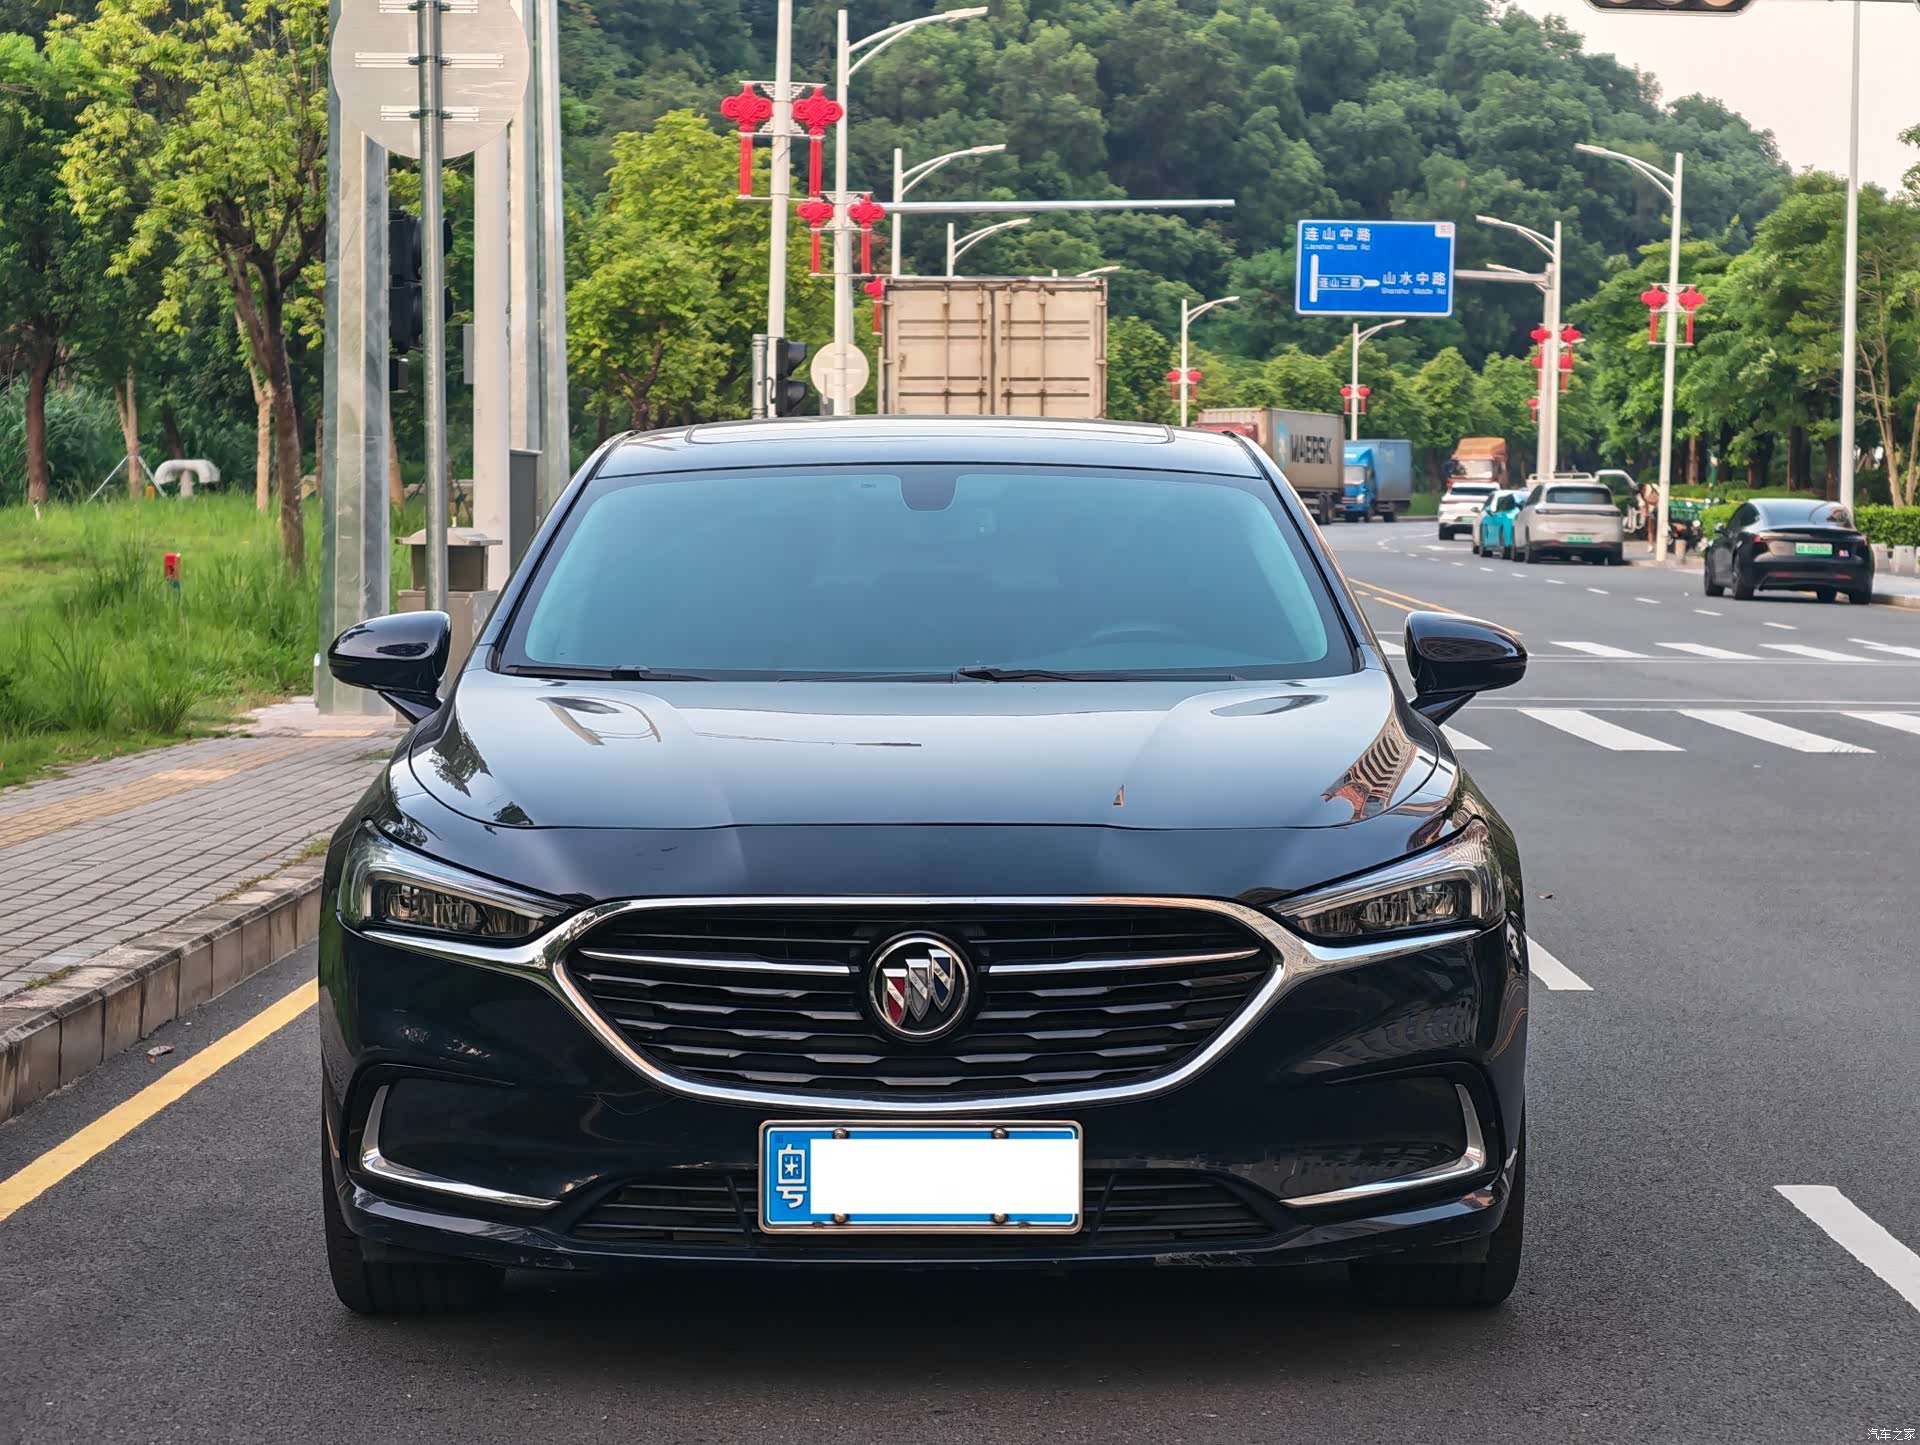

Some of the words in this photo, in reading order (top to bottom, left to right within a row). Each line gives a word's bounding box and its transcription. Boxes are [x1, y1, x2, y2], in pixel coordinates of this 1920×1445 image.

[1304, 226, 1371, 242] 连山中路
[1382, 271, 1446, 286] 山水中路
[1290, 434, 1332, 464] MAERSK
